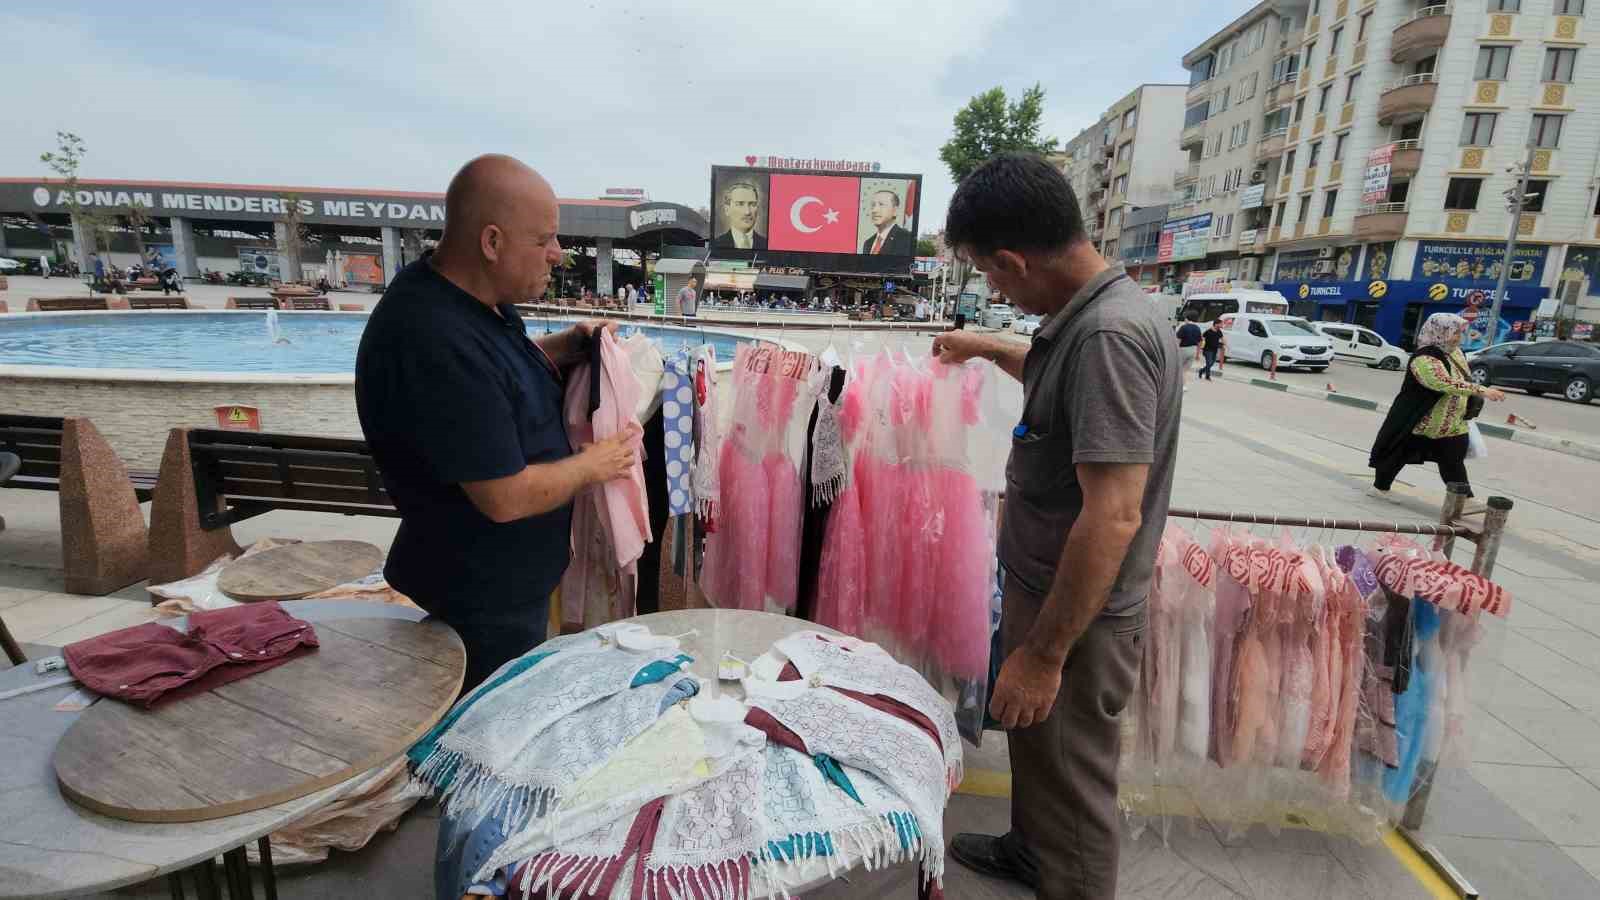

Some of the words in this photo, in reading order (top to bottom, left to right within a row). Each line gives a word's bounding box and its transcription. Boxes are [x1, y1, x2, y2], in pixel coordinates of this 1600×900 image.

[56, 190, 154, 208] ADNAN
[1310, 286, 1342, 296] TURKCELL
[1452, 287, 1511, 301] TUCEL
